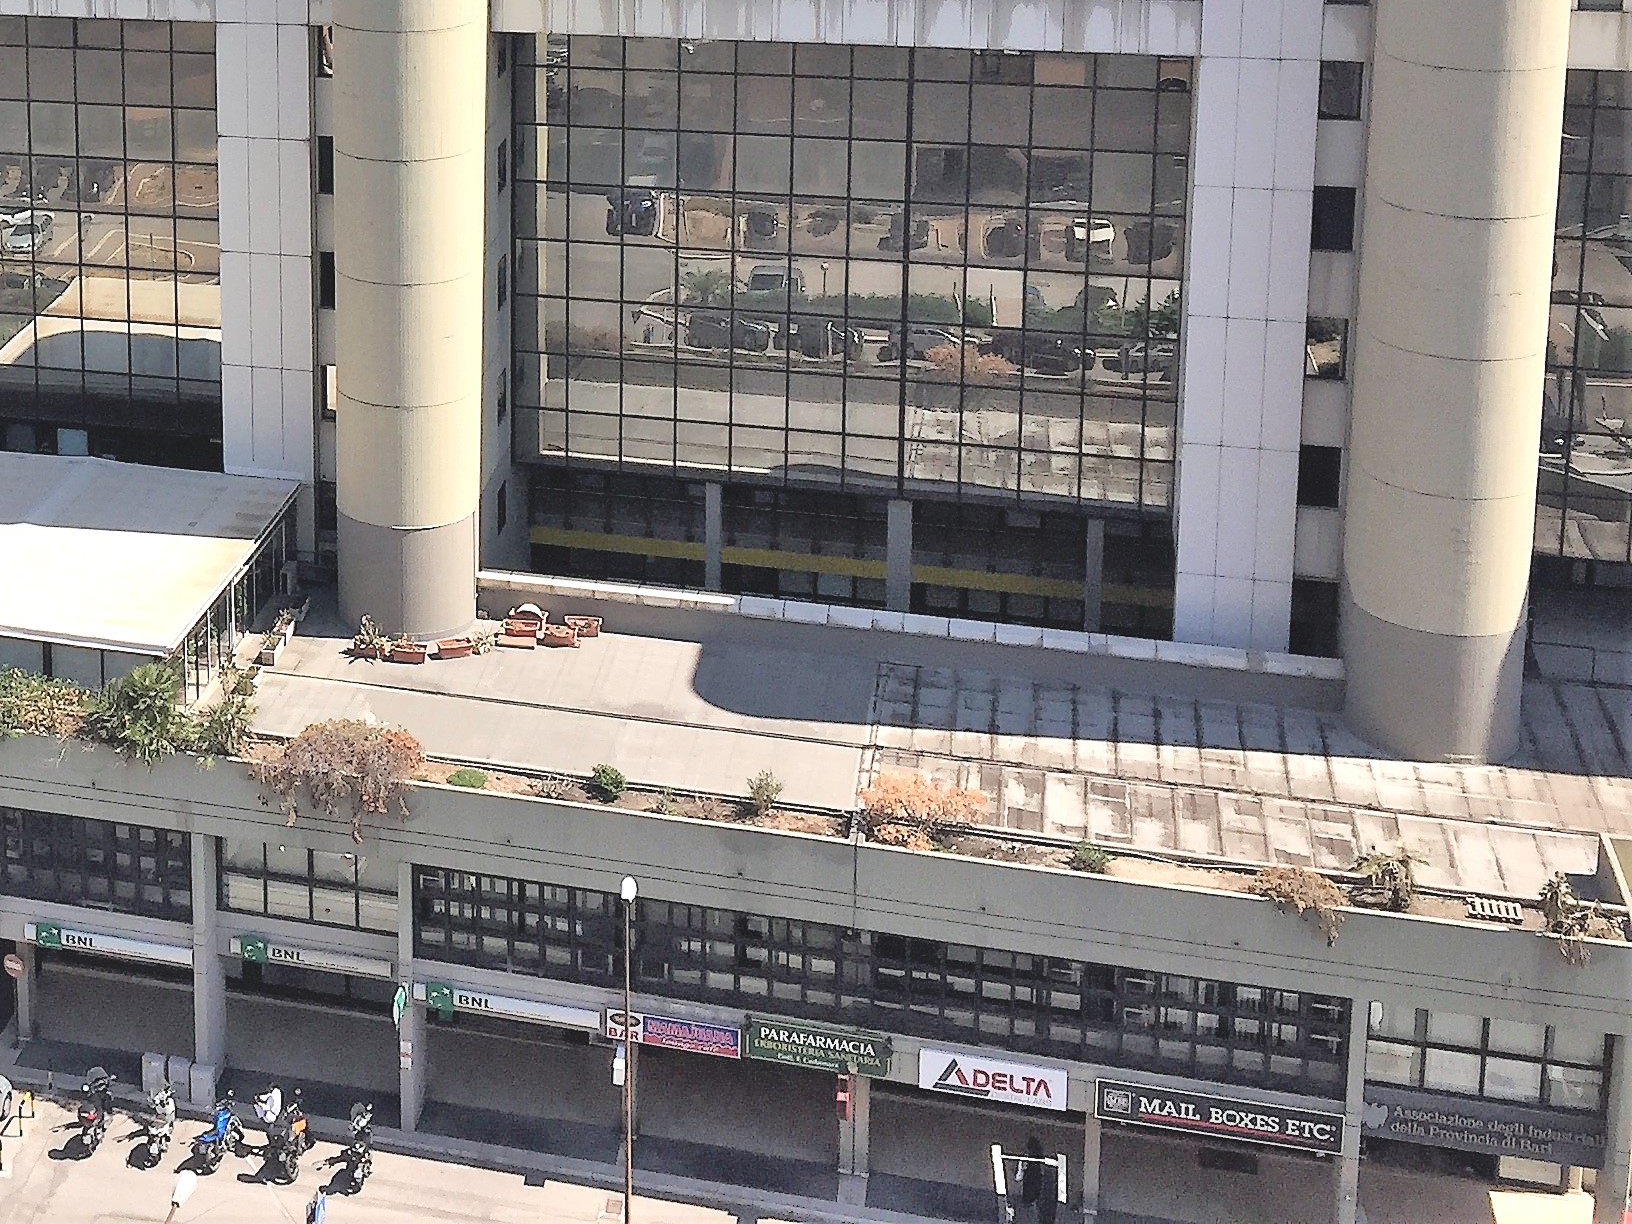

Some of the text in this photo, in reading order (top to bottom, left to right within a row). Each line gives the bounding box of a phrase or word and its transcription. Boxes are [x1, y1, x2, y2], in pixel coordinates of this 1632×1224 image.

[65, 934, 97, 948] BNL
[271, 947, 306, 962] BNL
[458, 994, 493, 1010] BNL
[609, 1027, 639, 1041] BAR
[760, 1026, 876, 1057] PARAFARMACIA
[754, 1038, 825, 1058] ERBORISTERIA
[1138, 1097, 1200, 1121] MAIL
[1209, 1107, 1279, 1133] BOXES
[1393, 1105, 1484, 1131] Associazione
[1487, 1120, 1524, 1136] degli
[1390, 1122, 1552, 1154] della Provincia di Bari
